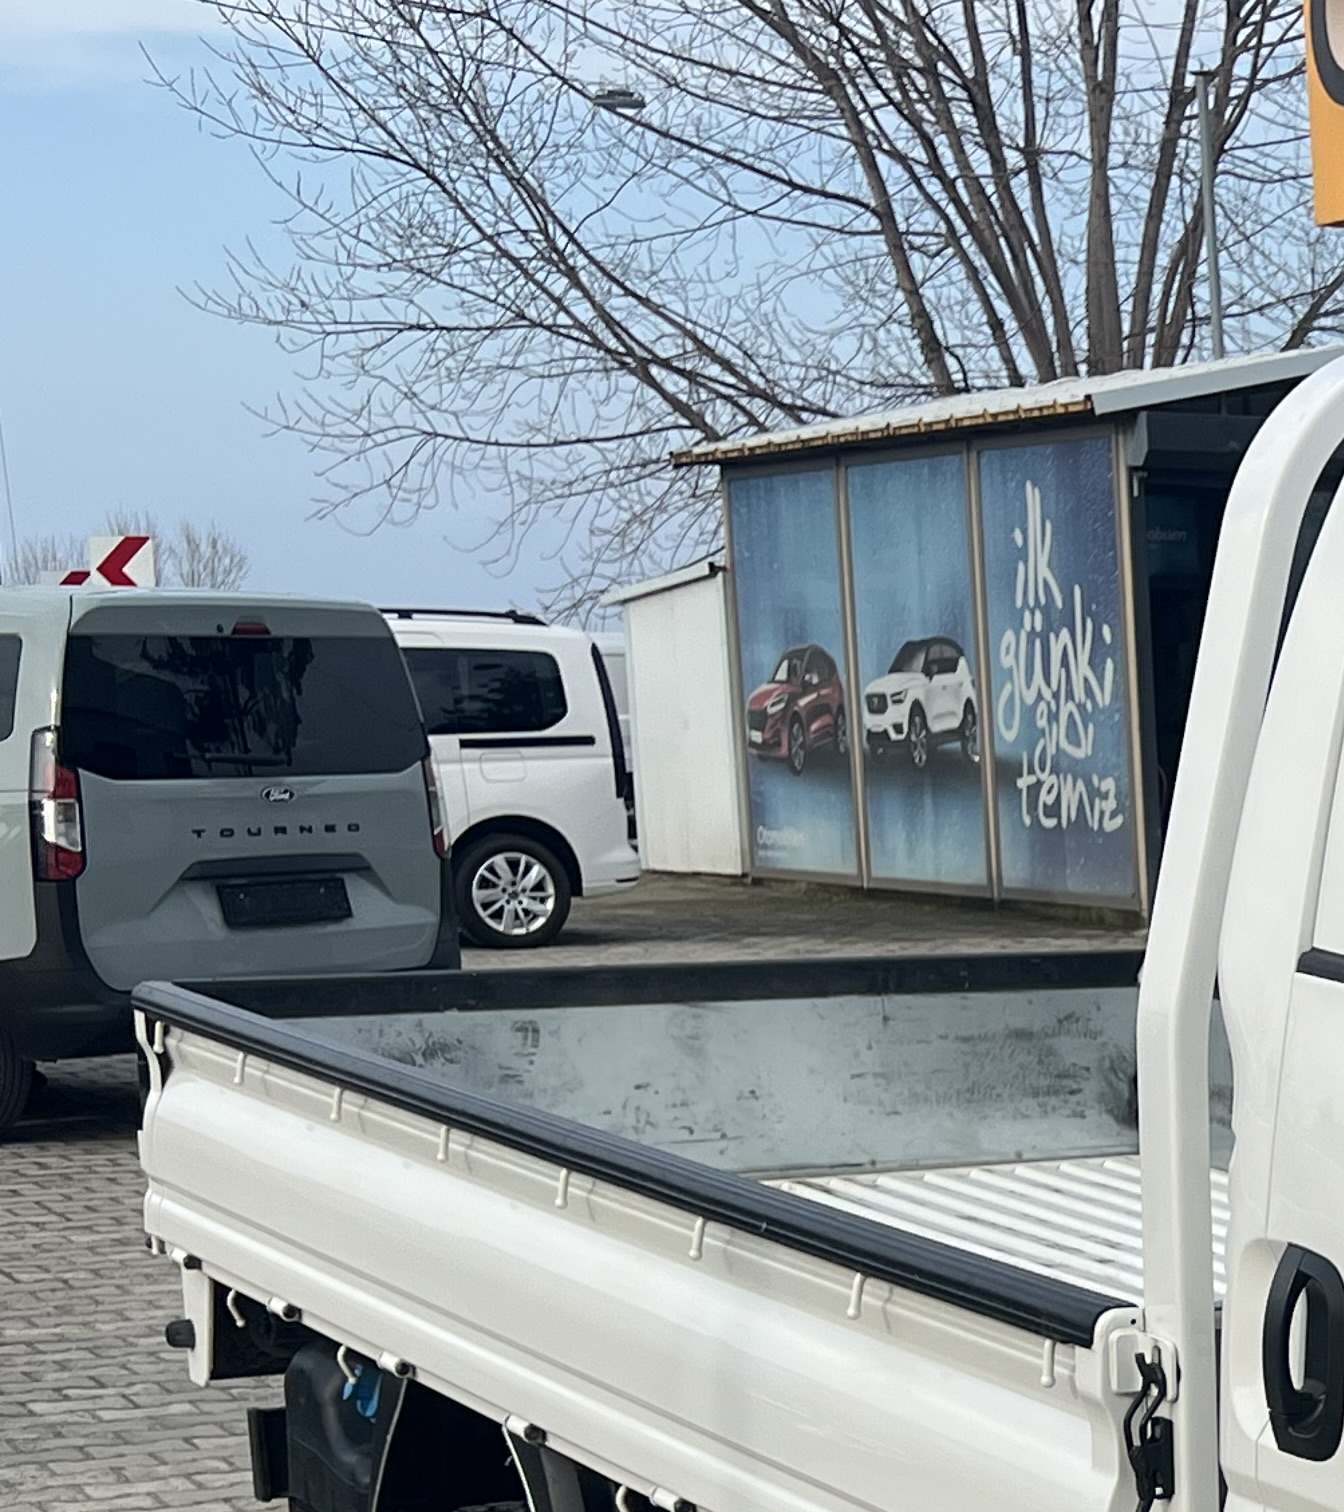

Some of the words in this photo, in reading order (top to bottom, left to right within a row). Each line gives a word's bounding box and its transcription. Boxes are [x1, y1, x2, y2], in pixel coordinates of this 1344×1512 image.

[1013, 480, 1063, 610] ilk
[998, 583, 1115, 743] günki
[1033, 668, 1096, 782] gibi
[191, 823, 361, 840] TOURNEO
[1016, 751, 1125, 833] temiz
